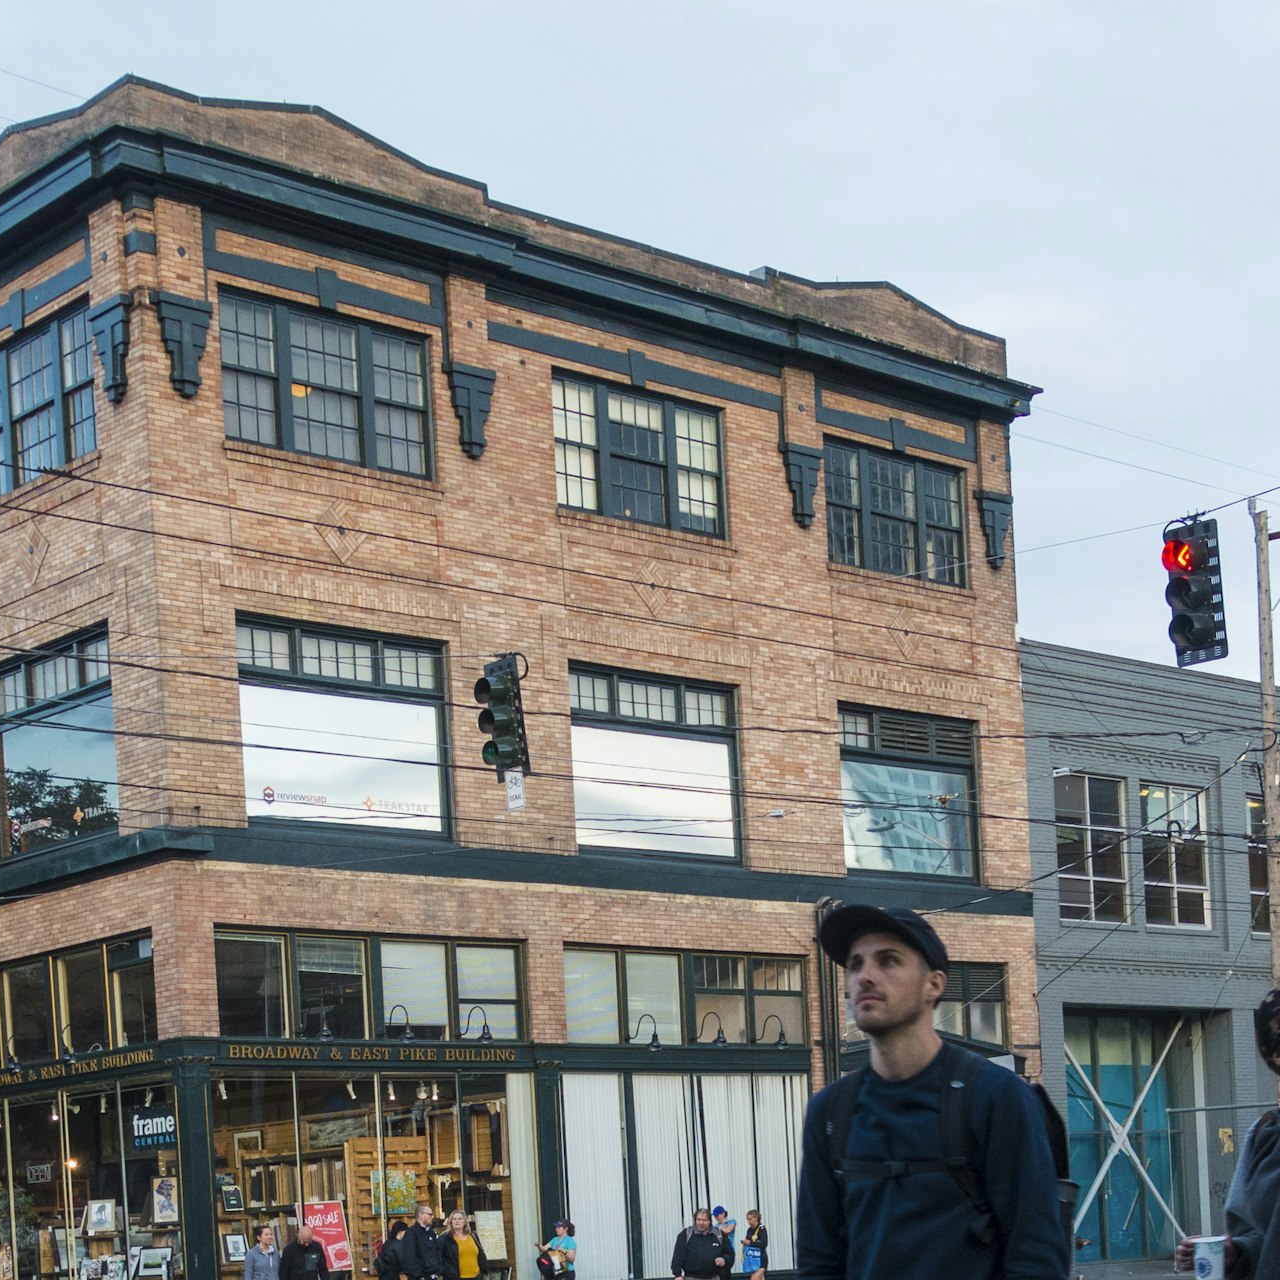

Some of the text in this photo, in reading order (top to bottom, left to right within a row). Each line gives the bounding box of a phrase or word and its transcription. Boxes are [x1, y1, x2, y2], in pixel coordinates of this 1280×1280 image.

[276, 792, 327, 804] reviewsnap
[378, 799, 429, 813] TRAKSTAR
[228, 1044, 516, 1062] BROADWAY & EAST PIKE BUILDING
[28, 1071, 37, 1082] &
[40, 1065, 67, 1079] EAST
[71, 1060, 98, 1075] PIKE
[102, 1049, 154, 1069] BUILDING
[132, 1114, 175, 1137] frame
[134, 1135, 176, 1146] CENTRAL
[28, 1166, 51, 1182] OPEN
[323, 1210, 339, 1225] SALE
